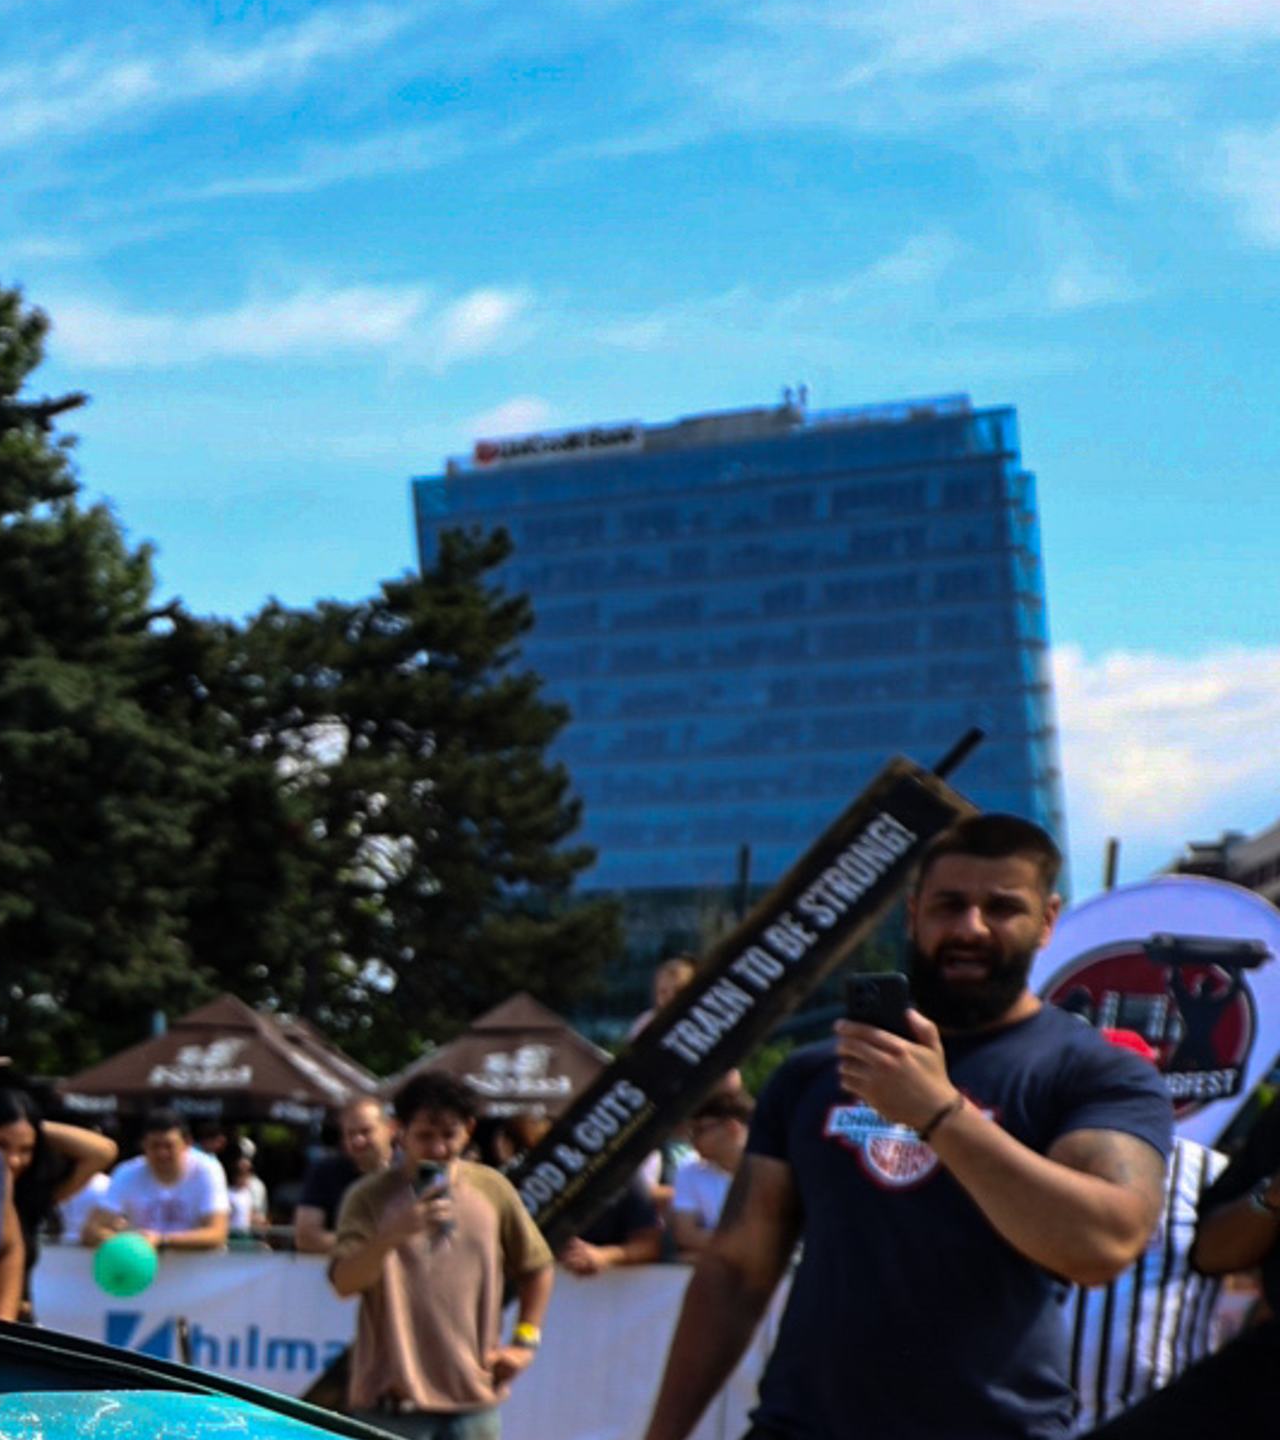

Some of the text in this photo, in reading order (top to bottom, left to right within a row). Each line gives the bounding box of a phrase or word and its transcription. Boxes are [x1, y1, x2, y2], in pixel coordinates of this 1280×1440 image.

[661, 812, 918, 1063] TRAIN TO BE STRONG!
[575, 1079, 646, 1152] GUTS
